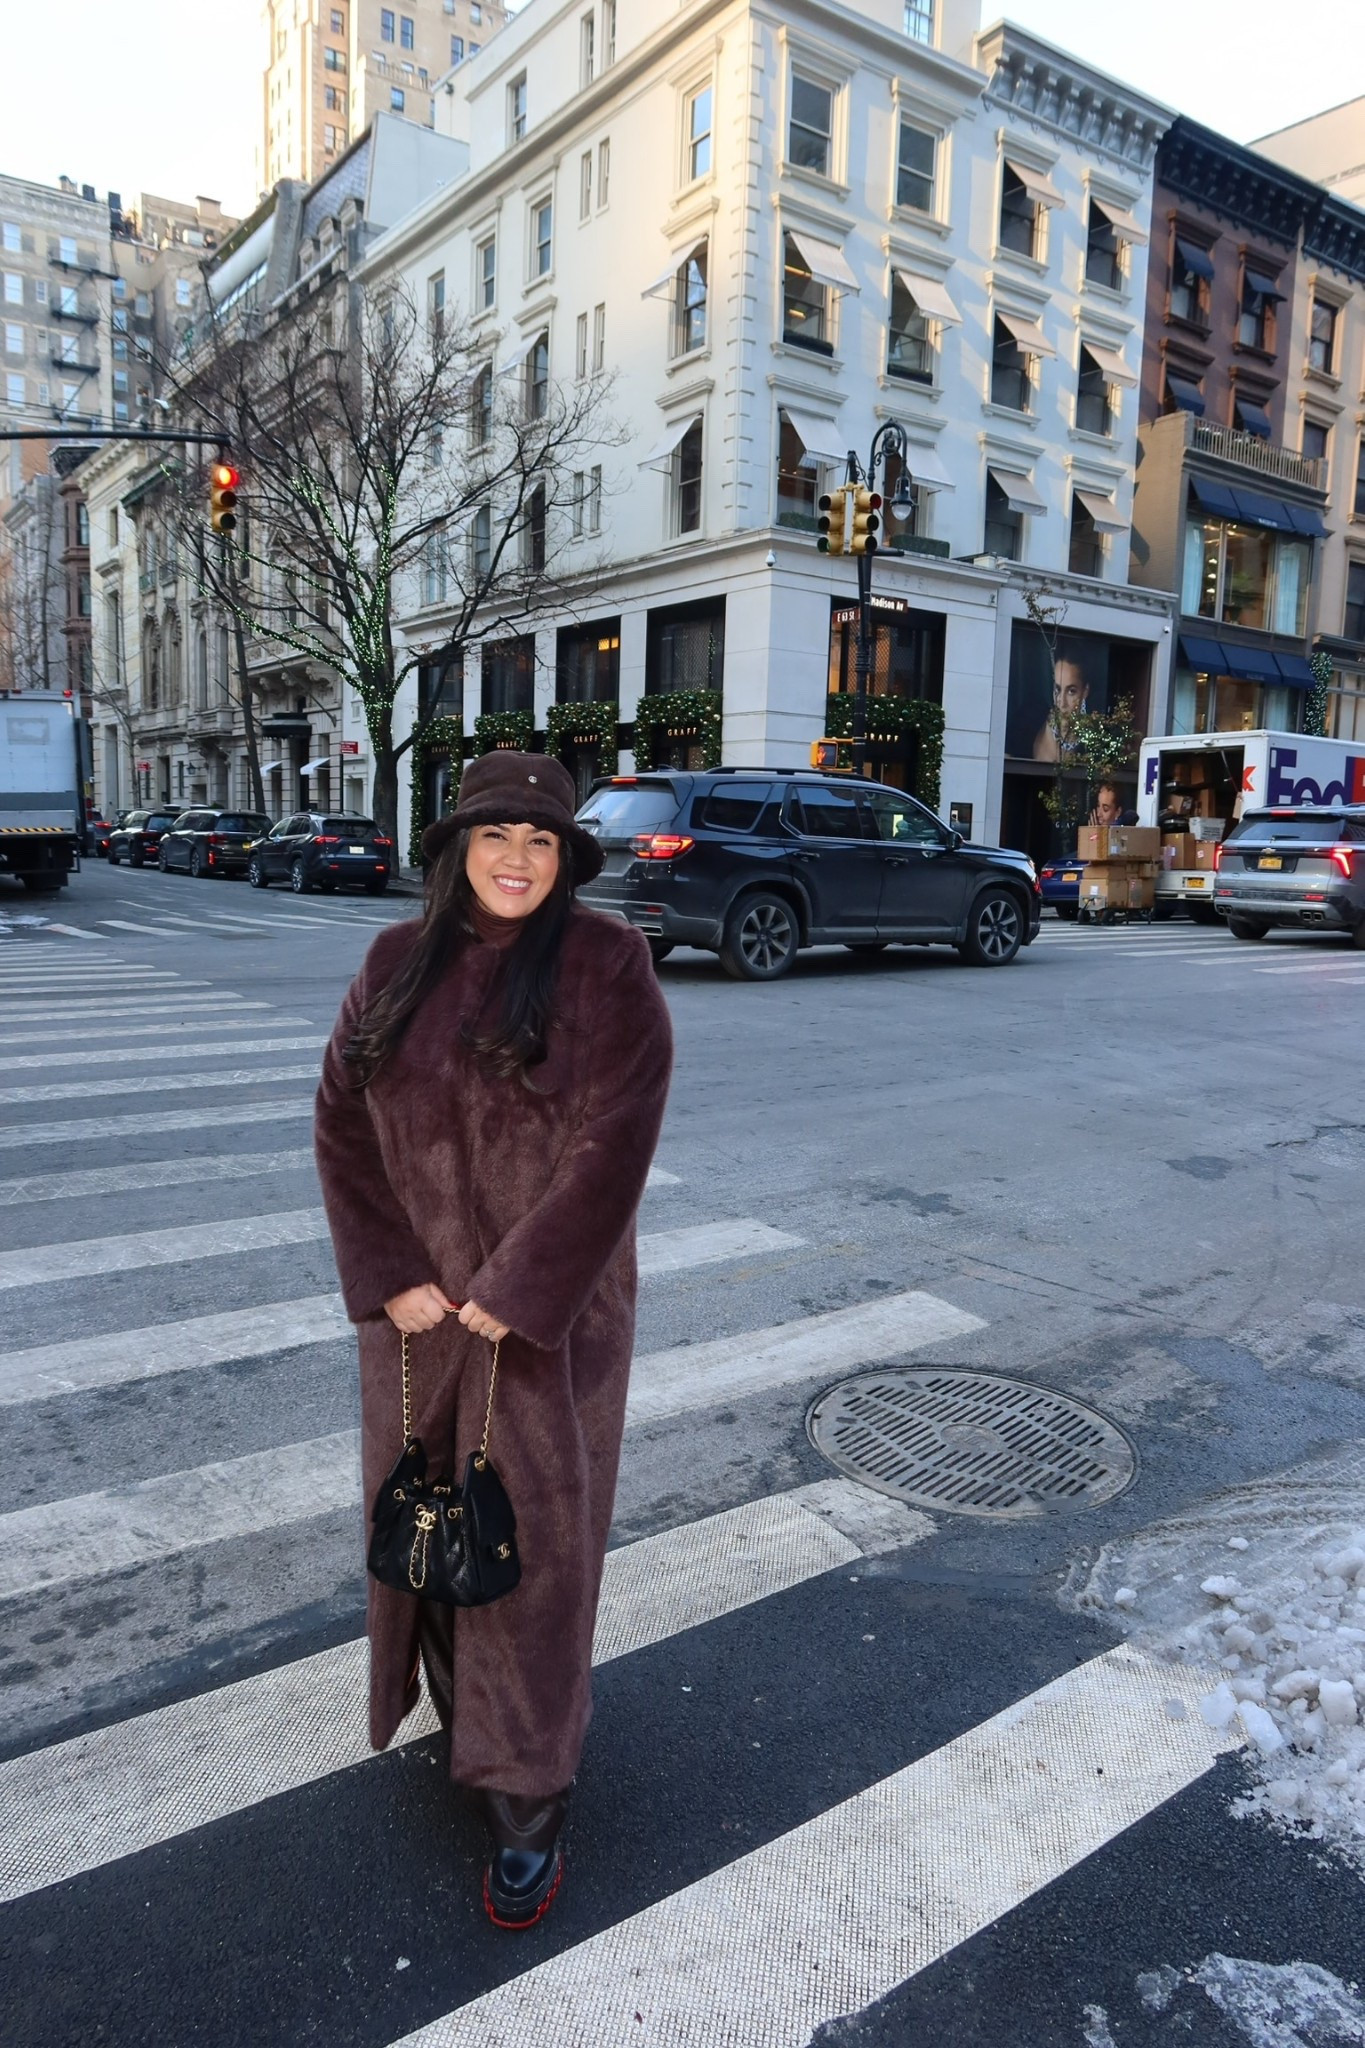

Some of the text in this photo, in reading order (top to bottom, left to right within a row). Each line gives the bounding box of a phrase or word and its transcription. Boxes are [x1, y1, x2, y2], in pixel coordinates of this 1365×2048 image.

[871, 597, 904, 612] Madison Av
[842, 612, 848, 621] 63
[849, 611, 855, 621] St
[668, 727, 697, 736] GRAFF
[573, 735, 598, 743] GRAFF
